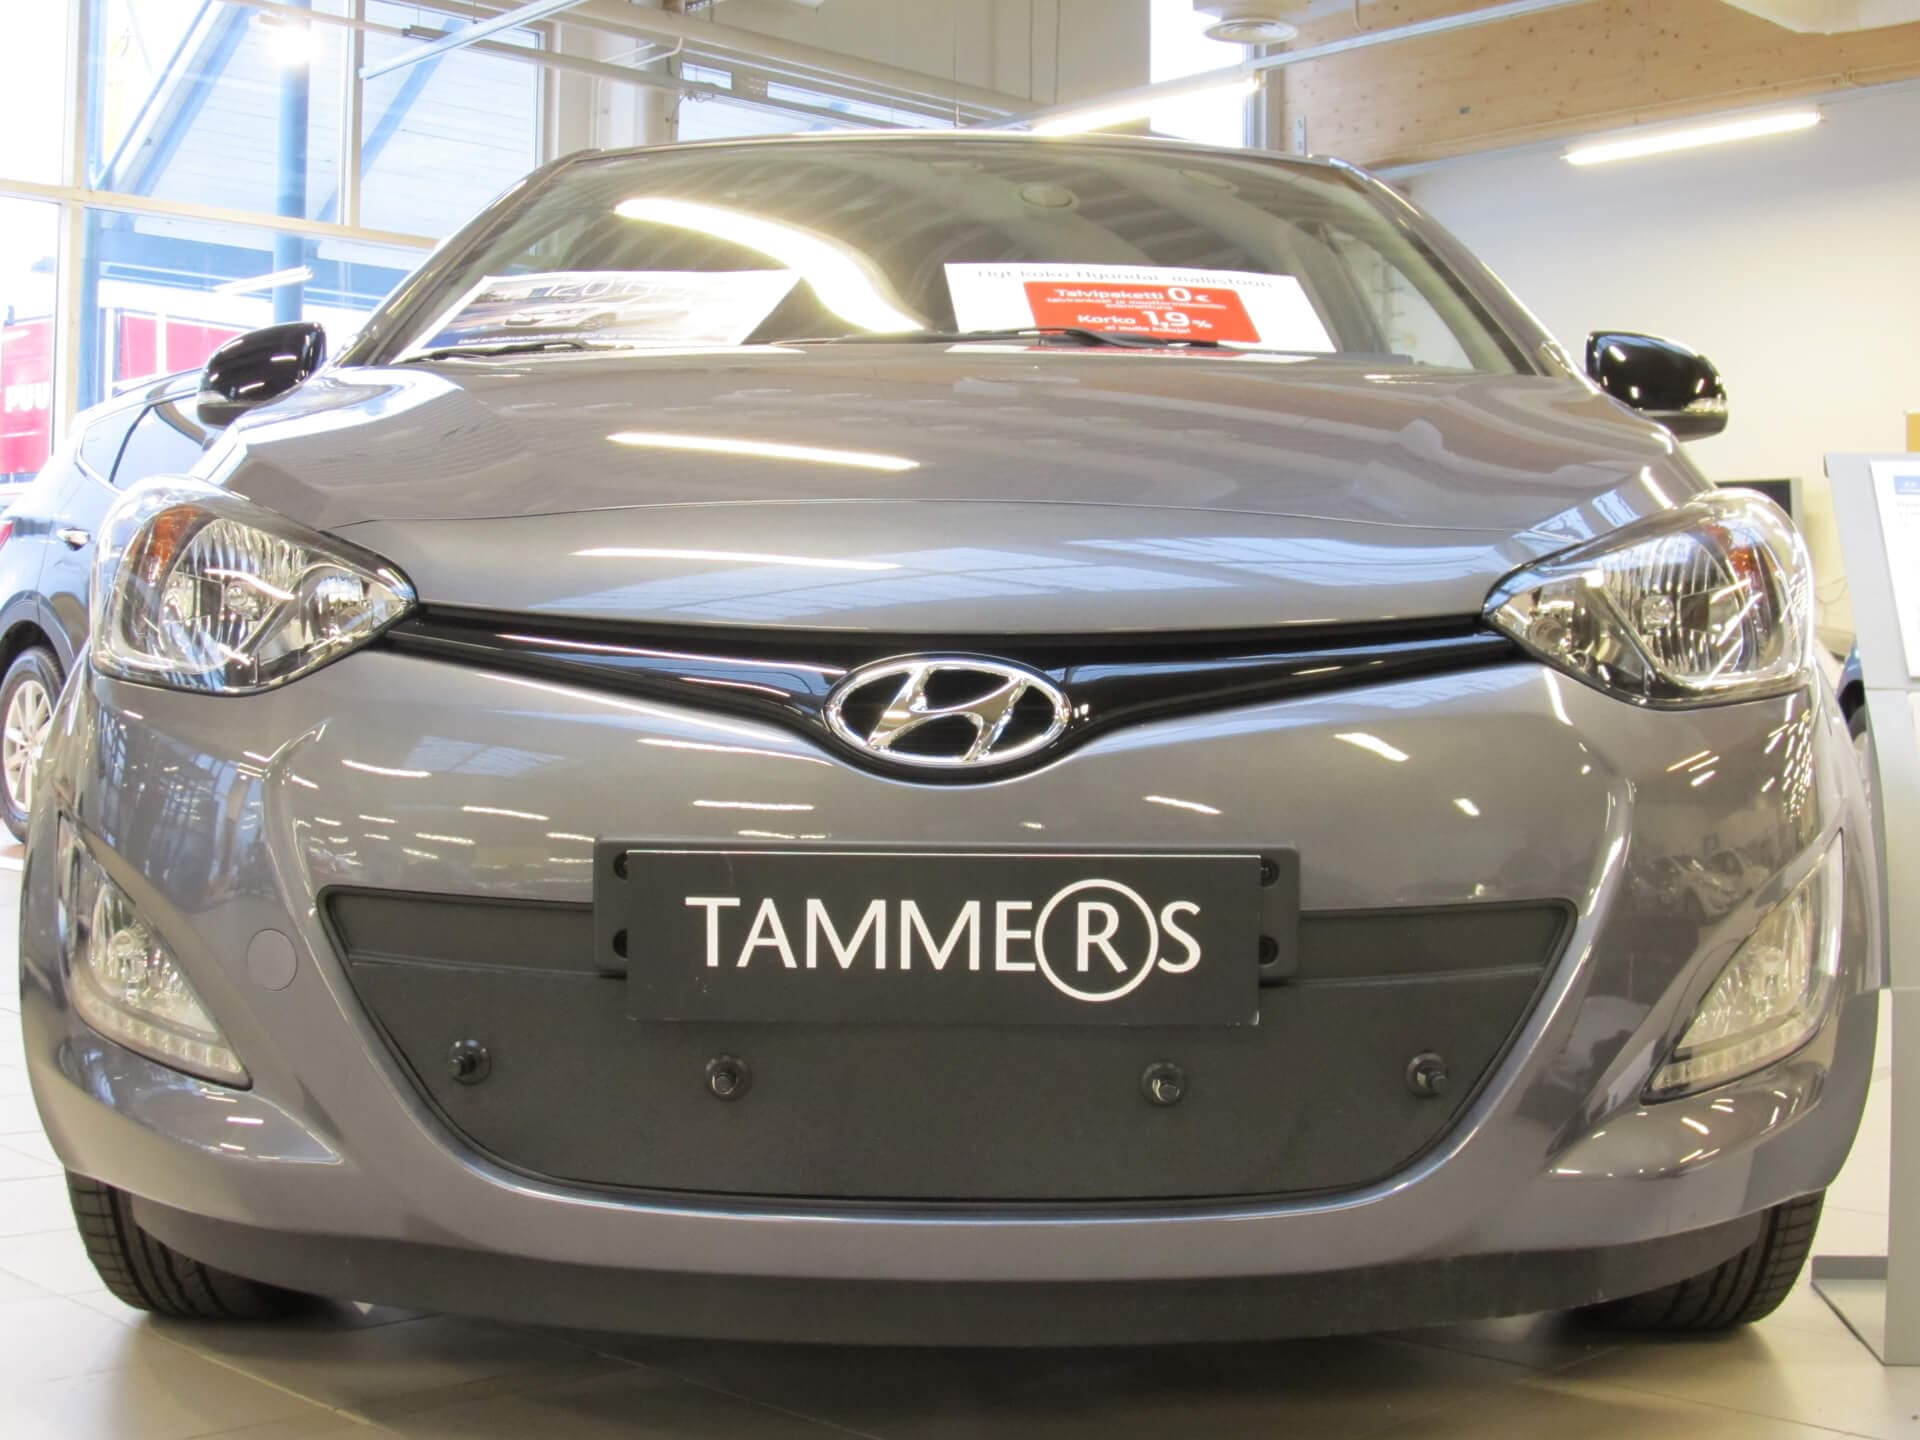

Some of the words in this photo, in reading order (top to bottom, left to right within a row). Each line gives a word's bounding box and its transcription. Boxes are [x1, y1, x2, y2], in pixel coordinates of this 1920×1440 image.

[1076, 271, 1159, 281] Hyundai
[1054, 289, 1164, 301] Talvipaketti
[1077, 314, 1136, 324] Korko
